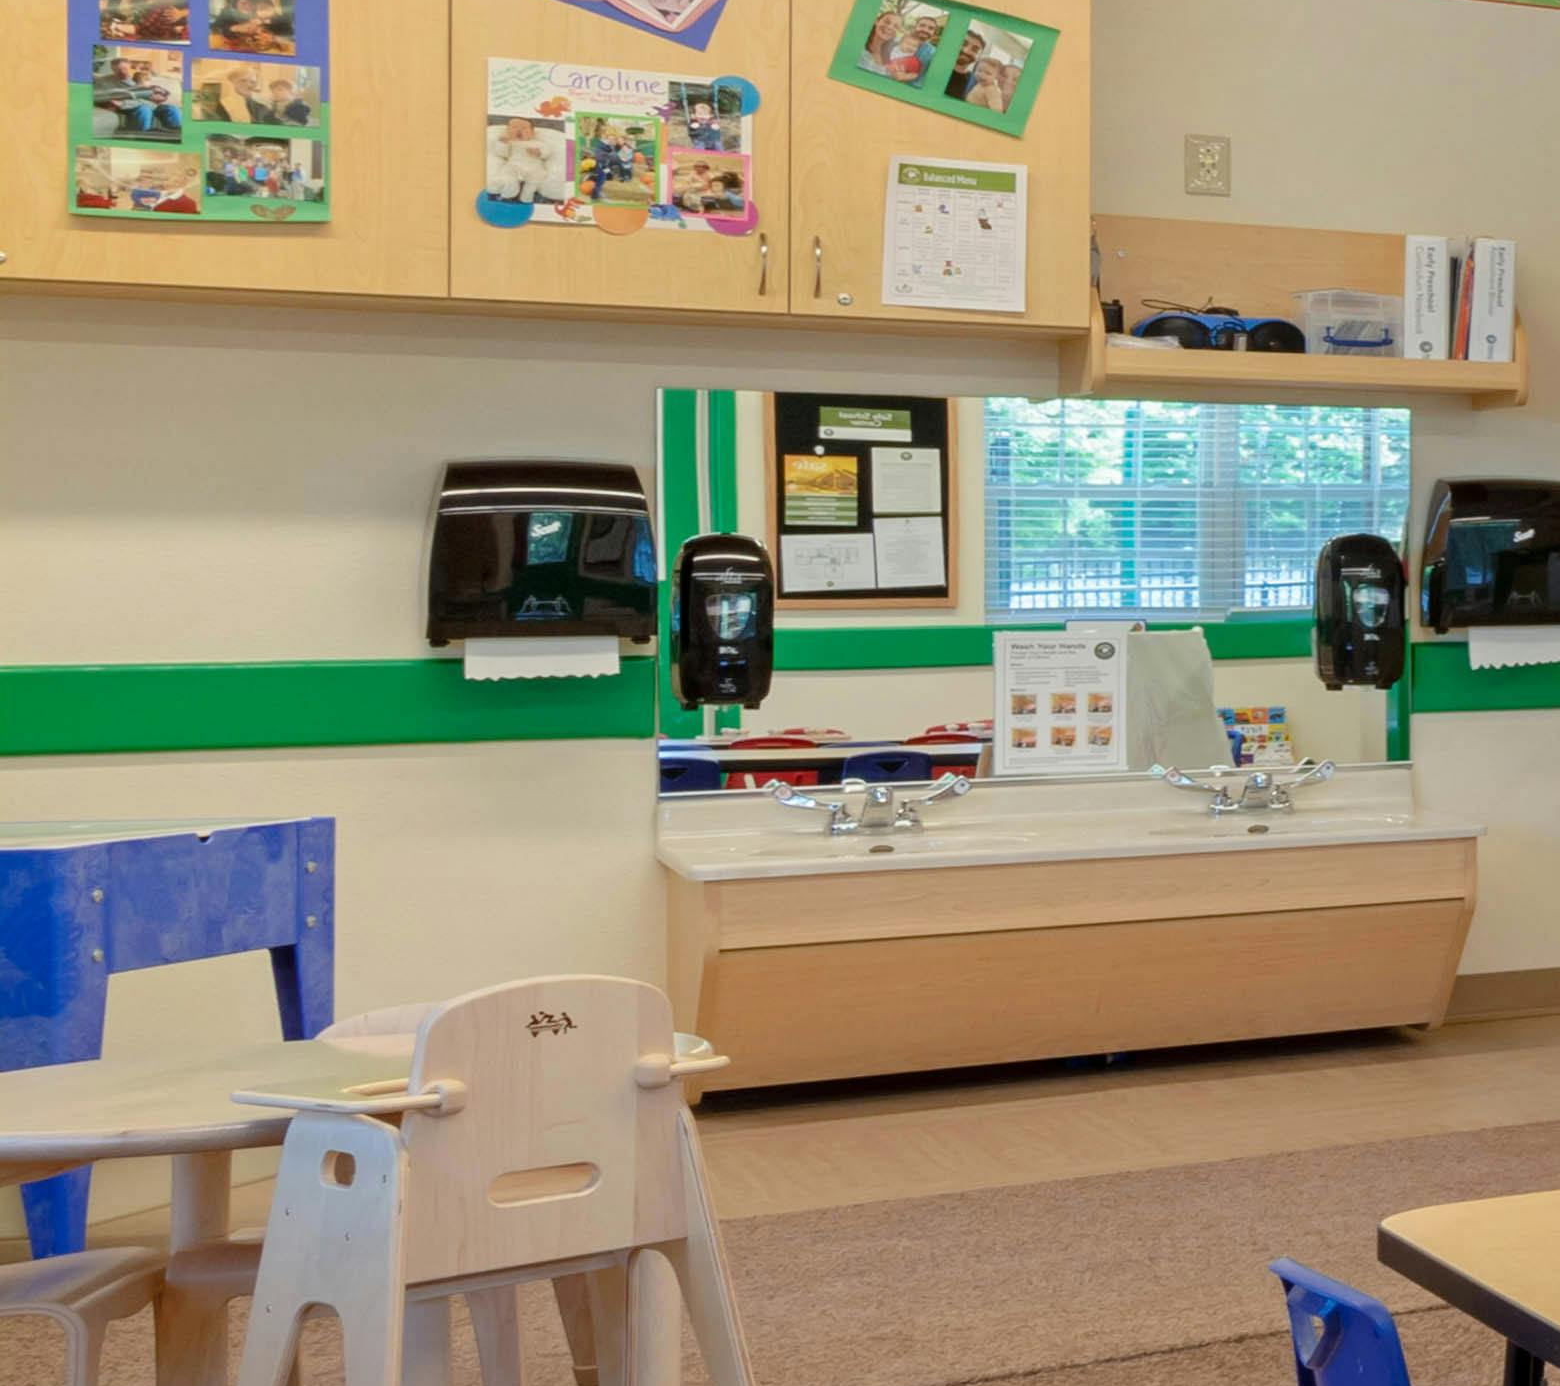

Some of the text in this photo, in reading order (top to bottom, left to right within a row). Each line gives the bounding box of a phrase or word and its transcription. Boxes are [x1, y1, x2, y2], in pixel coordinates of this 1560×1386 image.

[549, 63, 666, 95] Caroline
[1424, 246, 1436, 313] Early Preschool
[1496, 268, 1505, 308] Preschool
